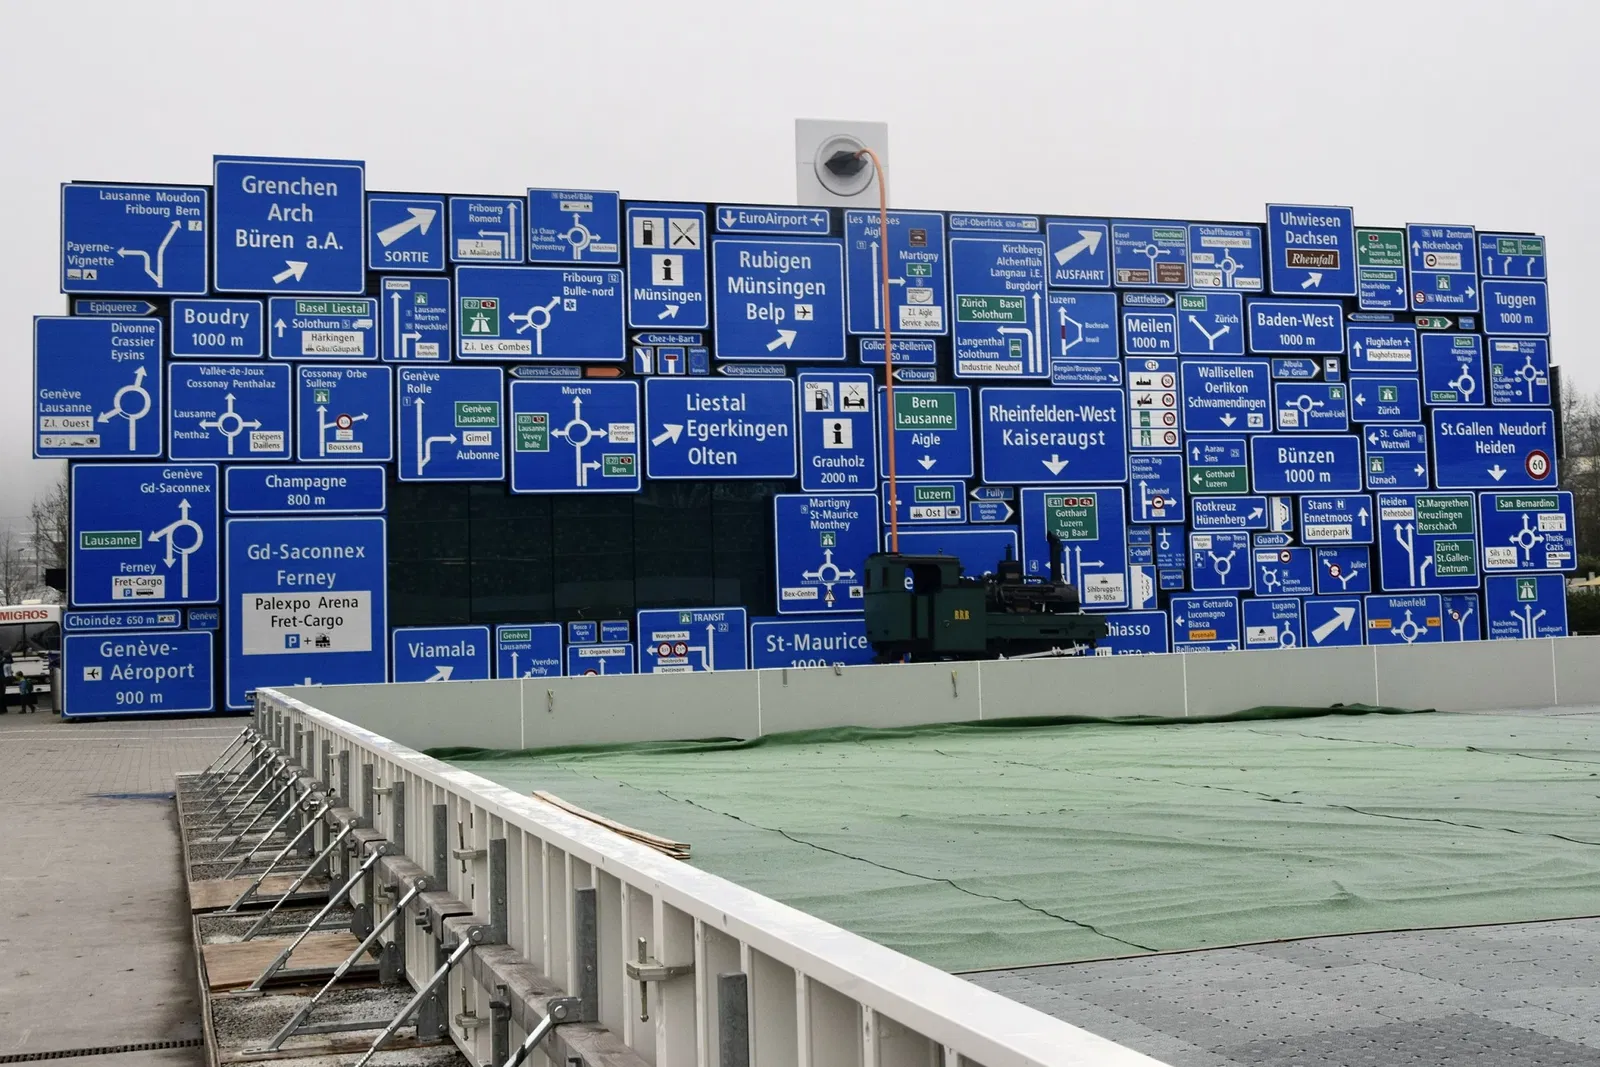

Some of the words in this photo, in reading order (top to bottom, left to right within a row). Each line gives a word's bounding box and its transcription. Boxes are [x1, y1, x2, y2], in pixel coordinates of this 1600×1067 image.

[242, 175, 337, 196] Grenchen
[100, 190, 151, 202] Lausanne
[156, 192, 200, 203] Moudon
[126, 204, 170, 218] Fribourg
[176, 205, 200, 216] Bern
[267, 203, 313, 222] Arch
[469, 203, 503, 215] Fribourg
[469, 214, 501, 223] Romont
[739, 212, 808, 228] EuroAirport
[849, 214, 863, 224] Les
[867, 215, 900, 225] Moses
[1280, 212, 1341, 227] Uhwiesen
[1199, 227, 1244, 236] Schaffhausen
[236, 229, 294, 248] Büren
[306, 232, 343, 250] a.A.
[1286, 230, 1338, 245] Dachsen
[67, 241, 114, 254] Payerne-
[532, 243, 566, 252] Porrentruy
[1002, 244, 1043, 257] Kirchberg
[1422, 241, 1463, 250] Rickenbach
[67, 255, 114, 268] Vignette
[385, 251, 429, 263] SORTIE
[740, 250, 811, 273] Rubigen
[900, 250, 939, 263] Martigny
[1292, 253, 1334, 267] Rheinfall
[563, 272, 603, 285] Fribourg
[608, 274, 619, 283] 12
[990, 268, 1026, 279] Langnau
[1030, 269, 1043, 278] i.E.
[1055, 269, 1104, 280] AUSFAHRT
[728, 276, 826, 300] Münsingen
[1005, 280, 1042, 292] Burgdorf
[634, 288, 702, 304] Münsingen
[1494, 292, 1536, 309] Tuggen
[299, 303, 327, 313] Basel
[332, 303, 366, 313] Liestal
[961, 298, 987, 308] Zürich
[1000, 299, 1022, 308] Basel
[1183, 298, 1204, 307] Basel
[185, 308, 249, 329] Boudry
[747, 302, 785, 325] Belp
[1500, 313, 1522, 324] 1000
[1257, 312, 1334, 327] Baden-West
[111, 322, 155, 333] Divonne
[1128, 318, 1172, 333] Meilen
[111, 336, 155, 347] Crassier
[192, 333, 225, 346] 1000
[231, 336, 243, 346] m
[311, 333, 355, 344] Härkingen
[957, 337, 1005, 348] Langenthal
[1132, 337, 1157, 348] 1000
[1160, 340, 1170, 348] m
[1280, 334, 1303, 345] 1000
[1306, 337, 1315, 345] m
[1366, 337, 1402, 348] Flughafen
[111, 349, 145, 362] Eysins
[302, 369, 343, 380] Cossonay
[346, 369, 368, 378] Orbe
[402, 371, 440, 381] Genève
[901, 369, 935, 379] Fribourg
[1198, 366, 1254, 378] Wallisellen
[186, 379, 229, 390] Cossonay
[233, 379, 276, 388] Penthalaz
[1205, 382, 1248, 393] Oerlikon
[40, 388, 81, 399] Genève
[562, 386, 592, 395] Murten
[687, 393, 745, 411] Liestal
[912, 397, 938, 408] Bern
[1188, 396, 1266, 411] Schwamendingen
[898, 413, 952, 424] Lausanne
[989, 404, 1116, 422] Rheinfelden-West
[687, 418, 788, 442] Egerkingen
[1380, 429, 1390, 438] St.
[1392, 429, 1416, 438] Gallen
[1441, 422, 1493, 436] St.Gallen
[1499, 422, 1546, 435] Neudorf
[252, 433, 281, 442] Eclépens
[465, 433, 490, 442] Gimel
[912, 433, 941, 448] Aigle
[1003, 428, 1105, 450] Kaiseraugst
[1475, 440, 1515, 454] Heiden
[688, 446, 737, 465] Olten
[1278, 447, 1335, 463] Bünzen
[812, 455, 865, 467] Grauholz
[1532, 459, 1543, 470] 60
[163, 469, 203, 479] Genève
[821, 472, 846, 483] 2000
[848, 475, 858, 483] m
[1285, 469, 1315, 483] 1000
[1319, 472, 1331, 482] m
[140, 482, 210, 493] Gd-Saconnex
[265, 474, 347, 491] Champagne
[918, 489, 951, 499] Luzern
[986, 489, 1005, 498] Fully
[287, 494, 310, 505] 800
[314, 496, 325, 505] m
[810, 498, 851, 510] Martigny
[1308, 500, 1332, 510] Stans
[1337, 500, 1344, 508] H
[1380, 497, 1407, 506] Heiden
[1417, 498, 1469, 509] St.Margrethen
[1500, 499, 1514, 508] San
[1516, 499, 1555, 508] Bernardino
[1196, 501, 1236, 511] Rotkreuz
[810, 509, 858, 519] St-Maurice
[1418, 510, 1463, 521] Kreuzlingen
[810, 520, 850, 531] Monthey
[1196, 514, 1246, 527] Hünenberg
[1056, 529, 1069, 538] Zug
[1307, 527, 1350, 538] Länderpark
[85, 535, 137, 546] Lausanne
[1257, 535, 1284, 545] Guarda
[248, 543, 365, 560] Gd-Saconnex
[1130, 548, 1151, 556] S-chanf
[1545, 543, 1564, 551] Cazis
[1437, 553, 1472, 562] St.Gallen-
[120, 562, 156, 575] Ferney
[114, 577, 162, 588] Fret-Cargo
[277, 570, 336, 589] Ferney
[784, 590, 816, 598] Bex-Centre
[256, 597, 311, 613] Palexpo
[318, 596, 358, 609] Arena
[1272, 602, 1296, 611] Lugano
[1389, 597, 1426, 607] Maienfeld
[0, 609, 48, 621] MIGROS
[69, 615, 122, 626] Choindez
[126, 615, 144, 625] 650
[693, 613, 725, 621] TRANSIT
[271, 614, 343, 630] Fret-Cargo
[1105, 622, 1150, 637] hiasso
[1191, 630, 1215, 639] Arsenale
[766, 632, 868, 652] St-Maurice
[100, 640, 178, 657] Genève-
[408, 640, 475, 658] Viamala
[1175, 645, 1210, 653] Bellinzona
[532, 658, 559, 666] Yverdon
[110, 663, 194, 683] Aéroport
[116, 691, 144, 705] 900
[150, 693, 163, 703] m
